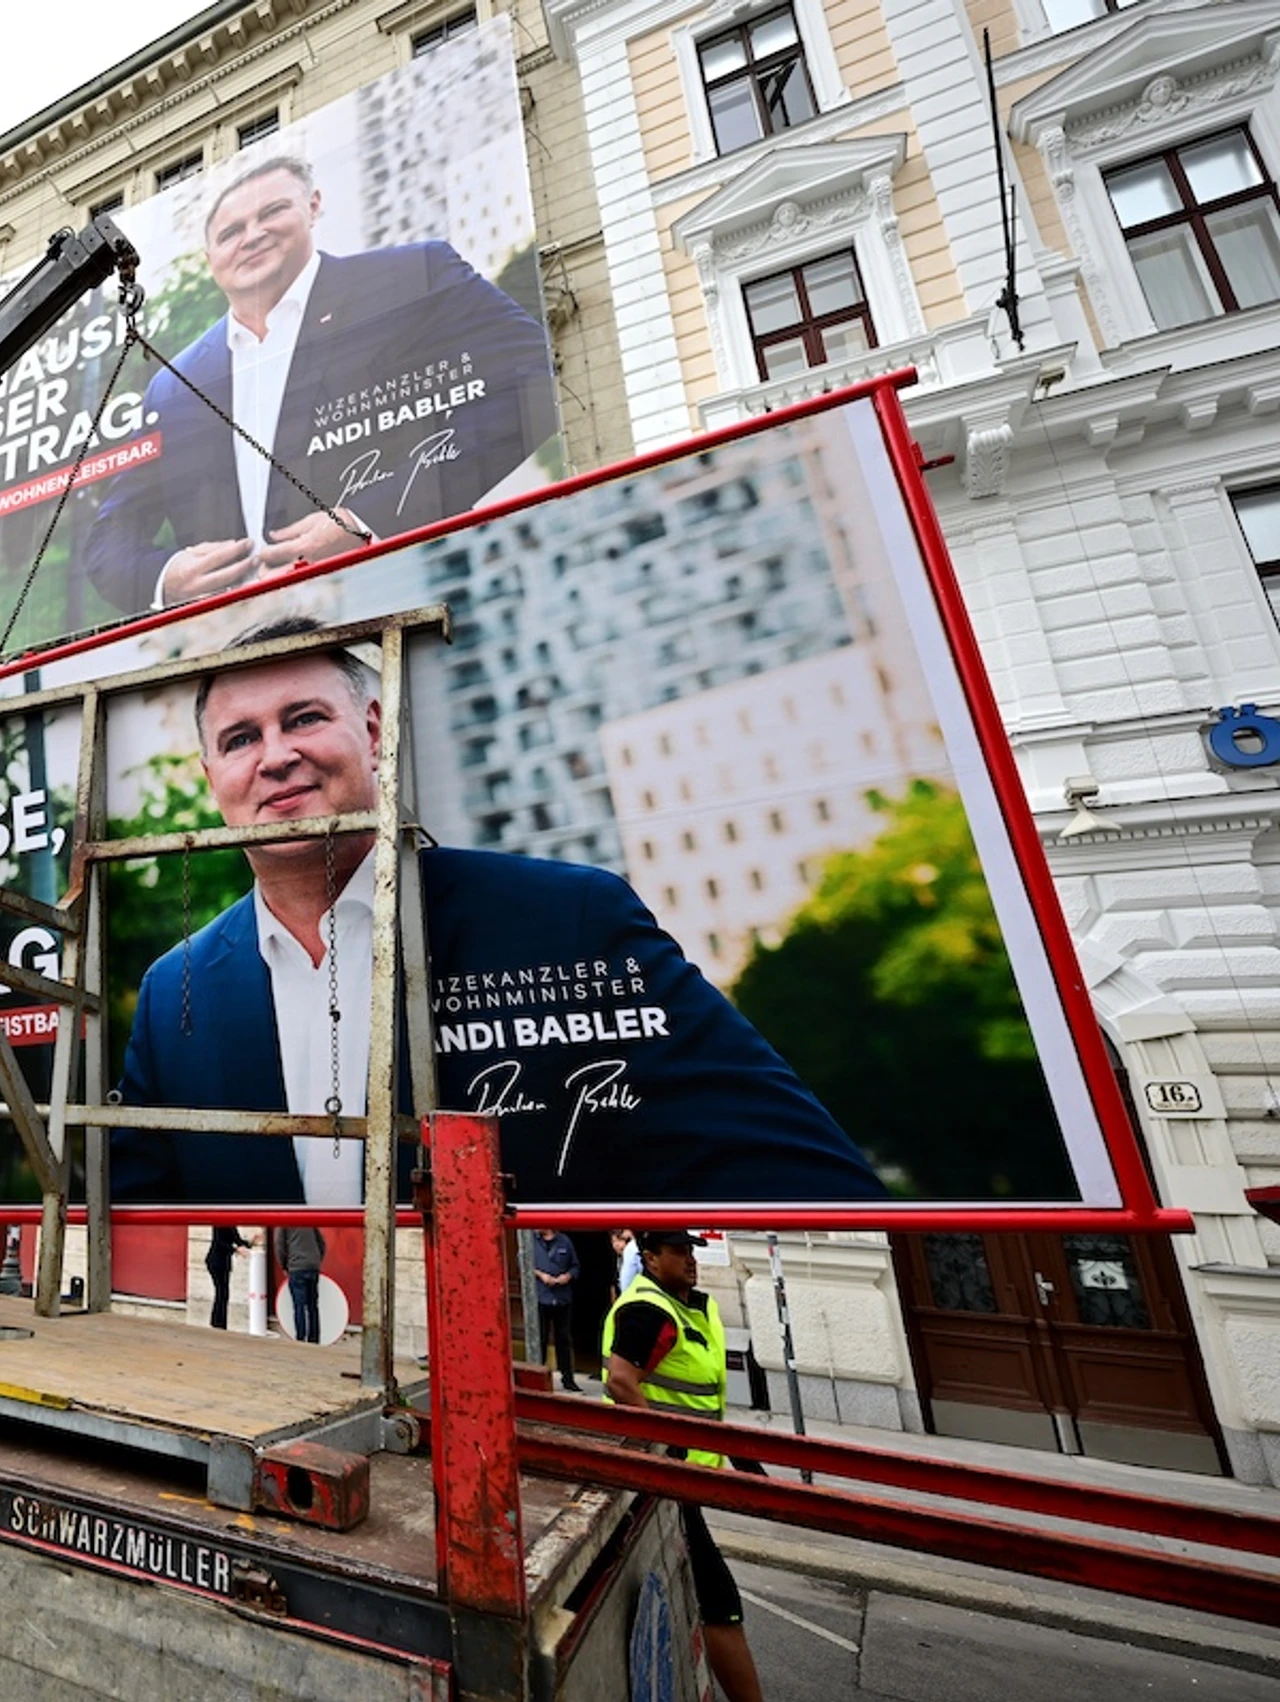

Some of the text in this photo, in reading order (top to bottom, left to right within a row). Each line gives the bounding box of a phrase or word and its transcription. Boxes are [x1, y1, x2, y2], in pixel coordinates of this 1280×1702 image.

[314, 364, 473, 428] WOHNMINISTER
[315, 352, 471, 416] VIZEKANZLER &
[306, 379, 487, 457] ANDI BABLER
[437, 957, 641, 993] IZEKANZLER &
[435, 1007, 670, 1053] NDI BABLER
[10, 1495, 231, 1594] SCHWARZMÜLLER
